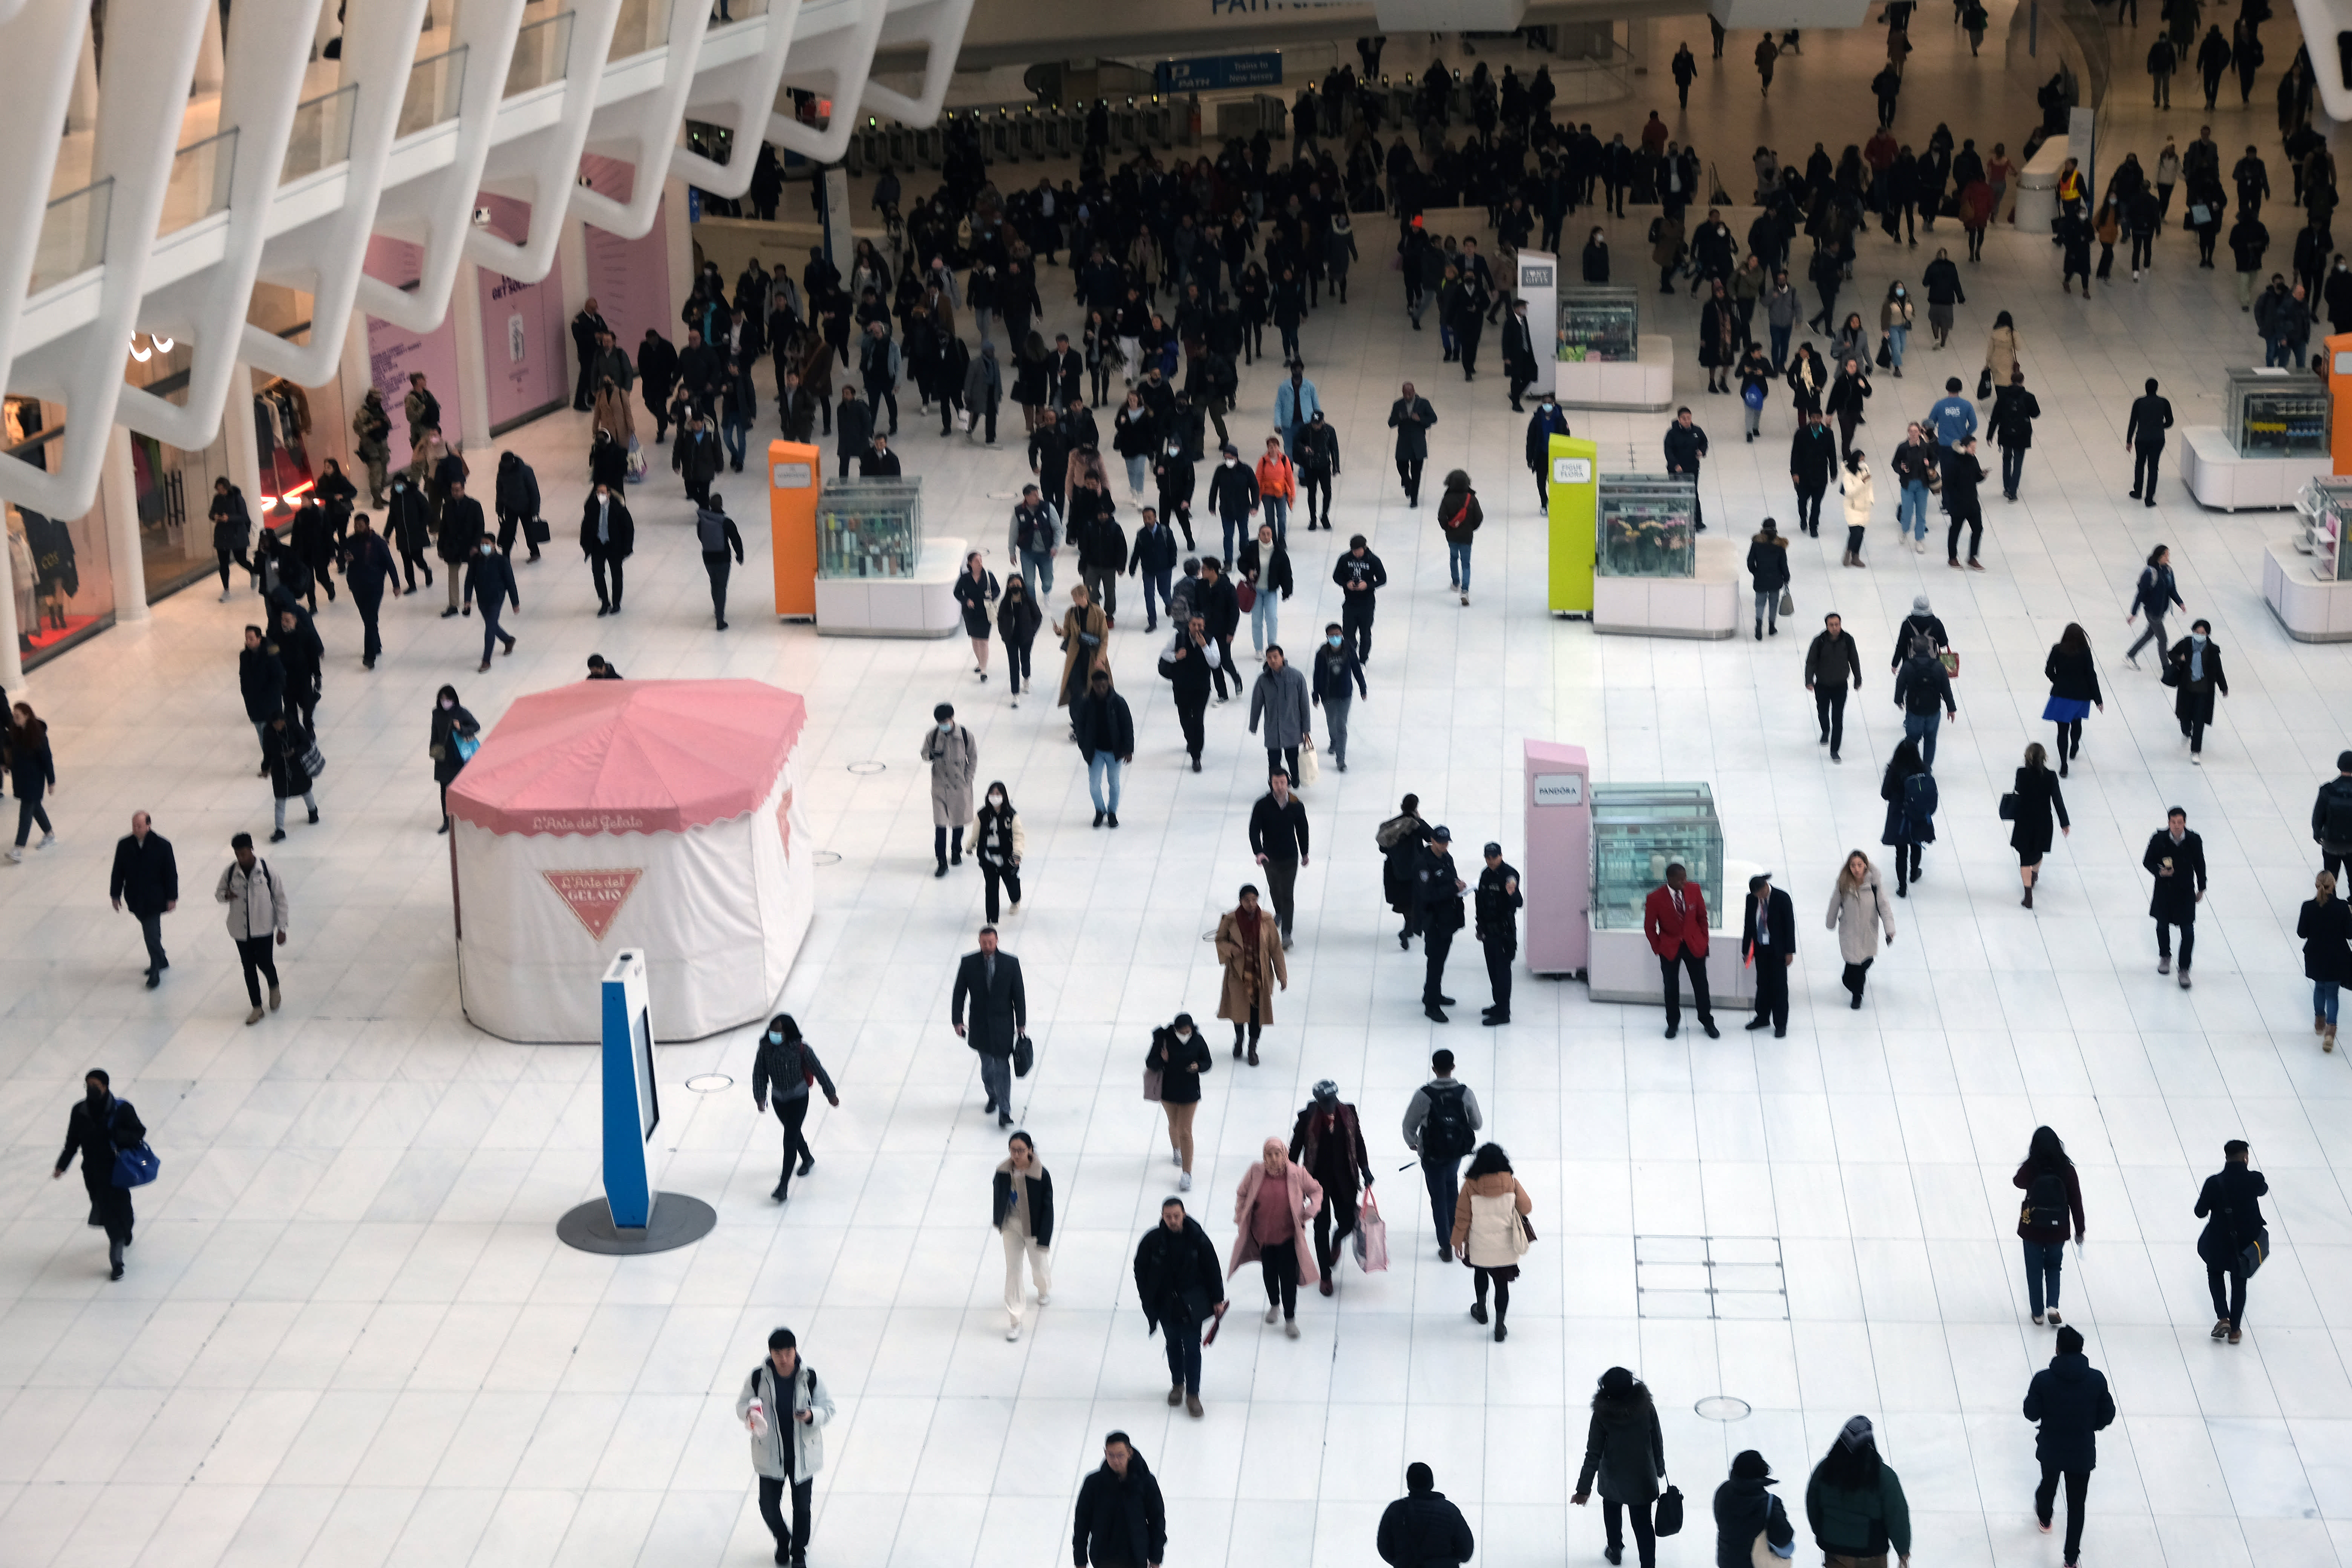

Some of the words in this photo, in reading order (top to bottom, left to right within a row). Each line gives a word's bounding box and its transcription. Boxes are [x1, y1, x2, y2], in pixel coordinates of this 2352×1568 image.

[1260, 60, 1269, 69] to
[1178, 77, 1210, 88] PATH
[1229, 74, 1248, 83] New
[1250, 72, 1274, 82] Jersey
[1539, 787, 1577, 795] PANDORA
[533, 816, 575, 830] L'Arte
[577, 815, 599, 829] del
[561, 876, 602, 889] L'Arte
[603, 874, 625, 888] del
[567, 888, 622, 902] GELATO
